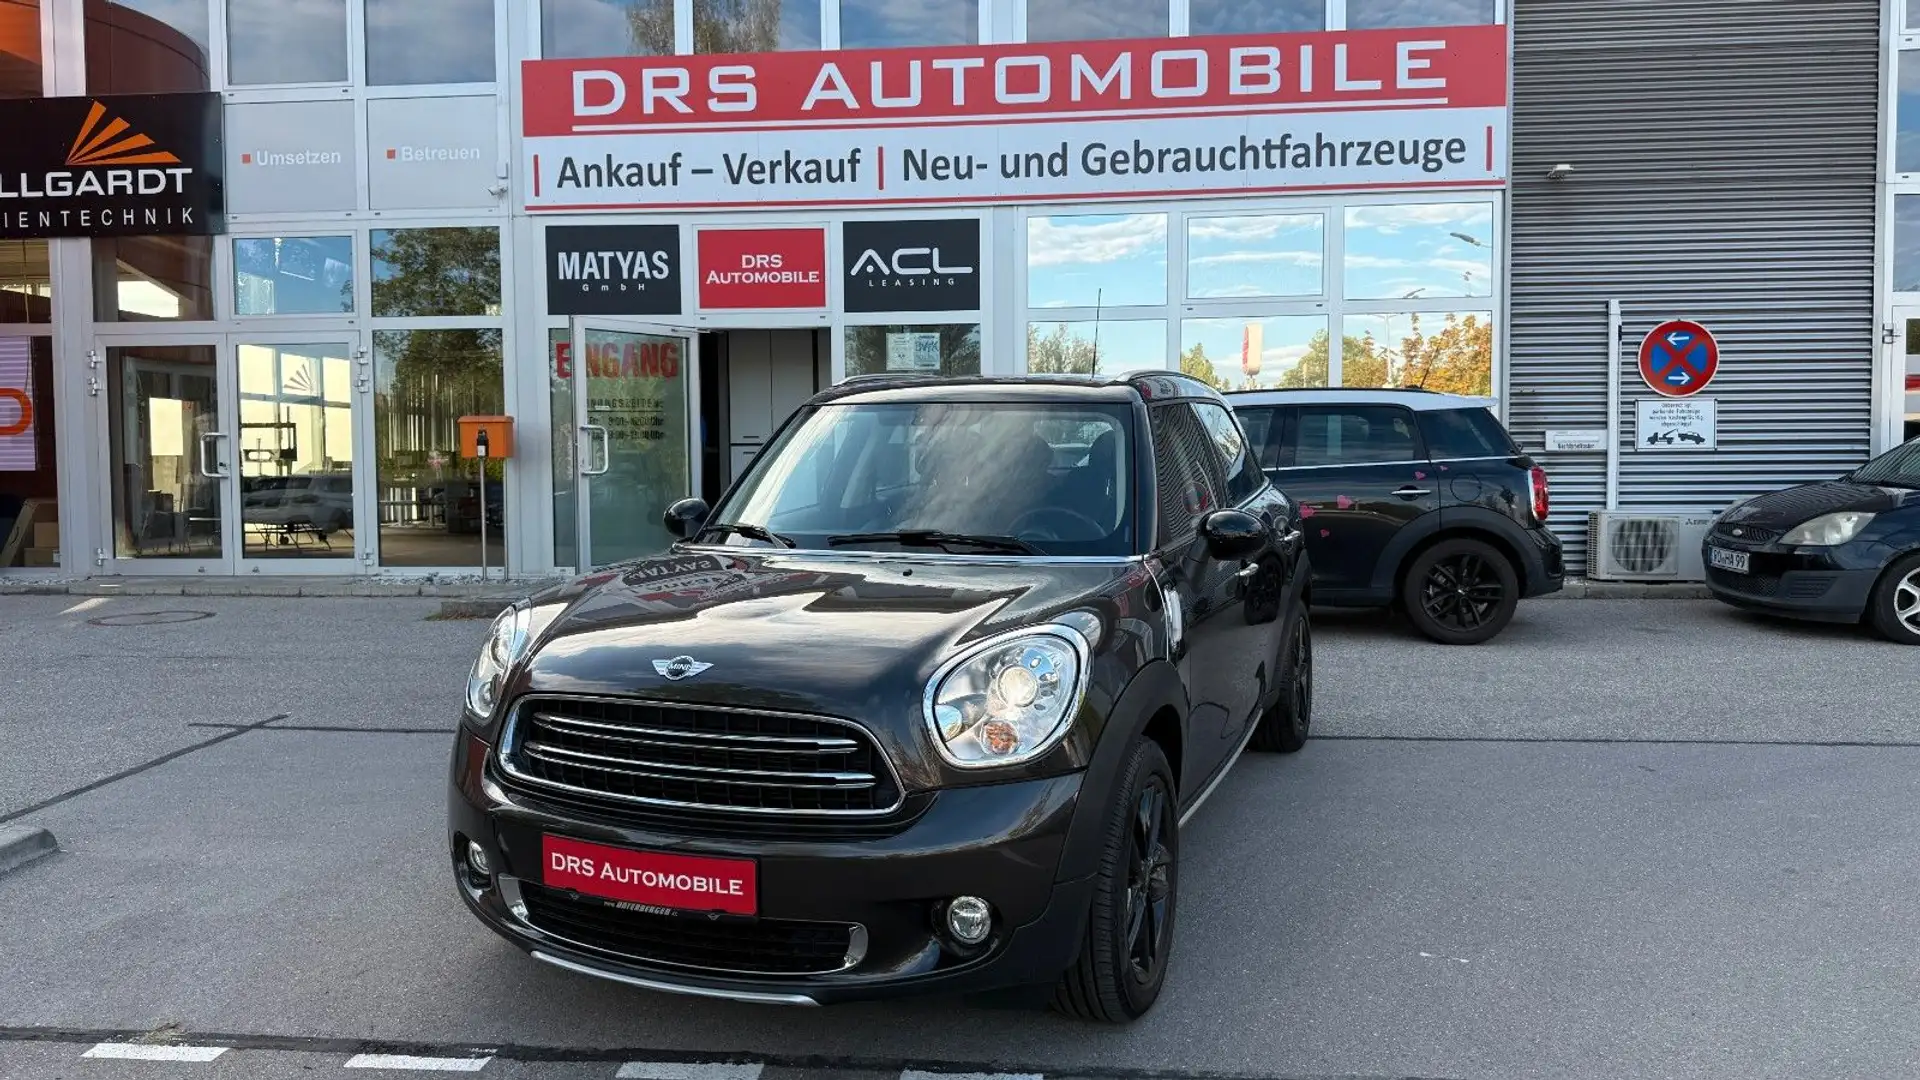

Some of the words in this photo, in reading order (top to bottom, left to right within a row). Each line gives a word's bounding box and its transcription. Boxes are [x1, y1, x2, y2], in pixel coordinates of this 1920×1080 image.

[572, 65, 757, 116] DRS
[801, 40, 1446, 110] AUTOMOBILE
[256, 150, 341, 166] Umsetzen
[401, 146, 480, 162] Betreuen
[557, 152, 682, 188] Ankauf
[722, 148, 861, 185] Verkauf
[903, 149, 988, 181] Neu-
[1000, 142, 1068, 178] und
[1081, 132, 1466, 176] Gebrauchtfahrzeuge
[4, 207, 194, 228] IENTECHNIK
[558, 250, 669, 280] MATYAS
[741, 254, 783, 268] DRS
[850, 247, 973, 276] ACL
[706, 270, 820, 284] AUTOMOBILE
[869, 278, 955, 287] LEASING
[556, 343, 678, 379] ENGANG
[551, 852, 595, 877] DRS
[600, 862, 744, 895] AUTOMOBILE
